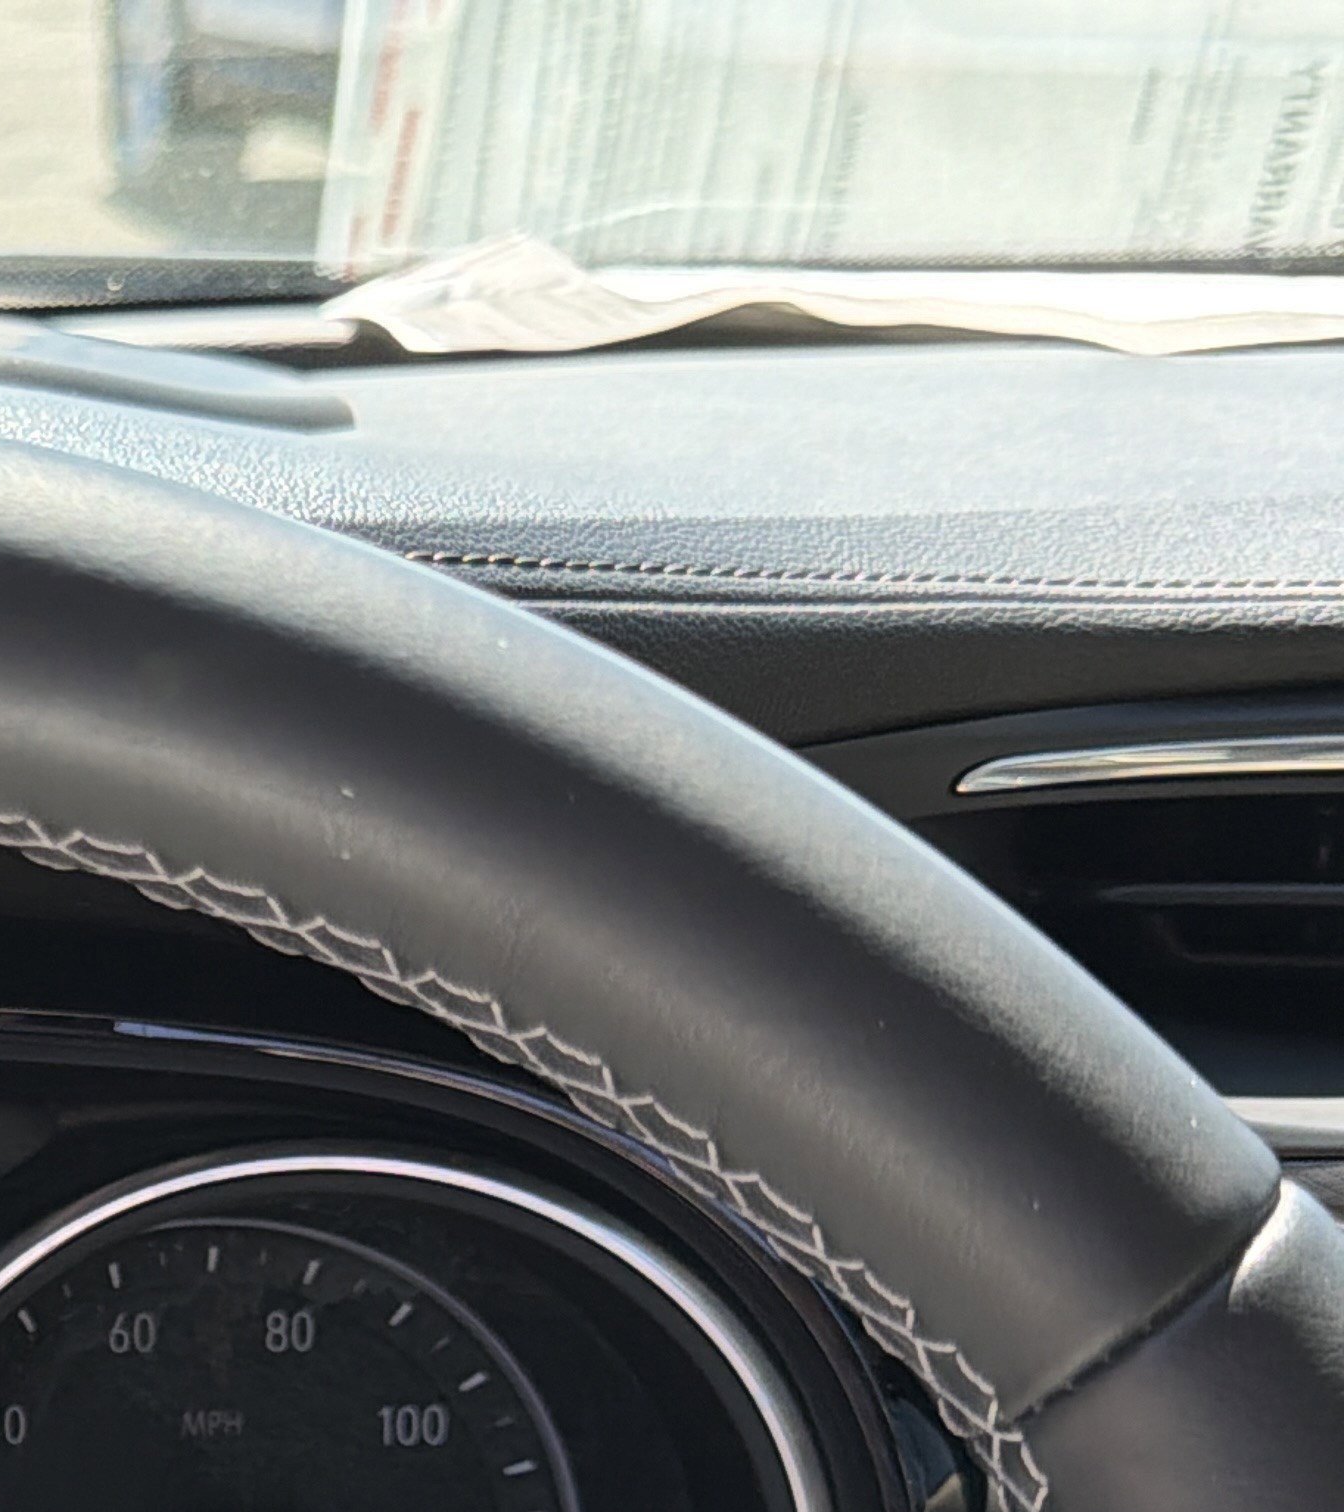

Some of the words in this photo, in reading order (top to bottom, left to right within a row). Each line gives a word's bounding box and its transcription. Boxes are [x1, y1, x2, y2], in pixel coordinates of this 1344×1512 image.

[109, 1312, 157, 1354] 60
[266, 1310, 314, 1353] 80
[181, 1411, 245, 1436] MPH
[378, 1404, 449, 1448] 100
